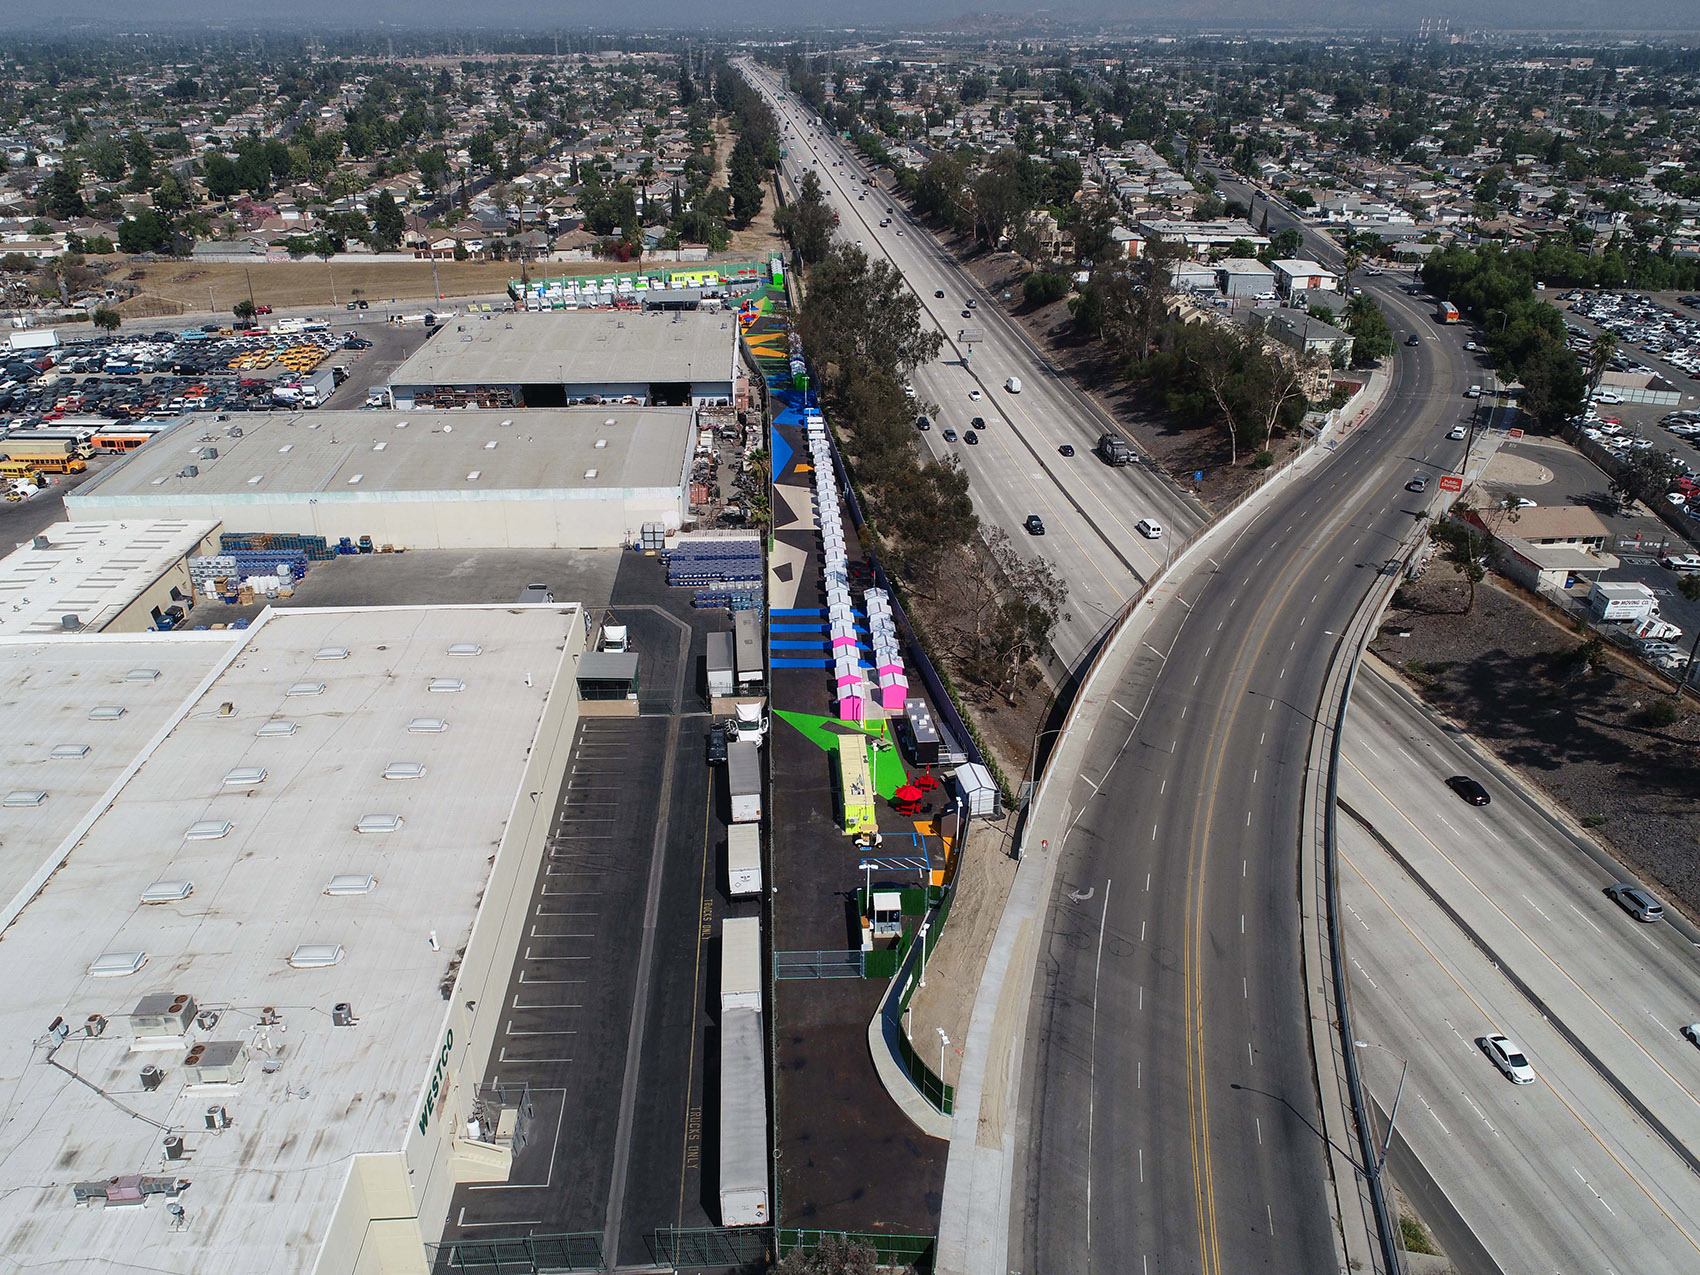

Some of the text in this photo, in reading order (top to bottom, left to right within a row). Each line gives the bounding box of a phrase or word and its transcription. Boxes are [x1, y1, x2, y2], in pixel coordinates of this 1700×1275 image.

[701, 899, 713, 940] TRUCKS ONLY
[418, 1028, 454, 1136] WESTCO
[687, 1106, 702, 1169] TRUCKS ONLY
